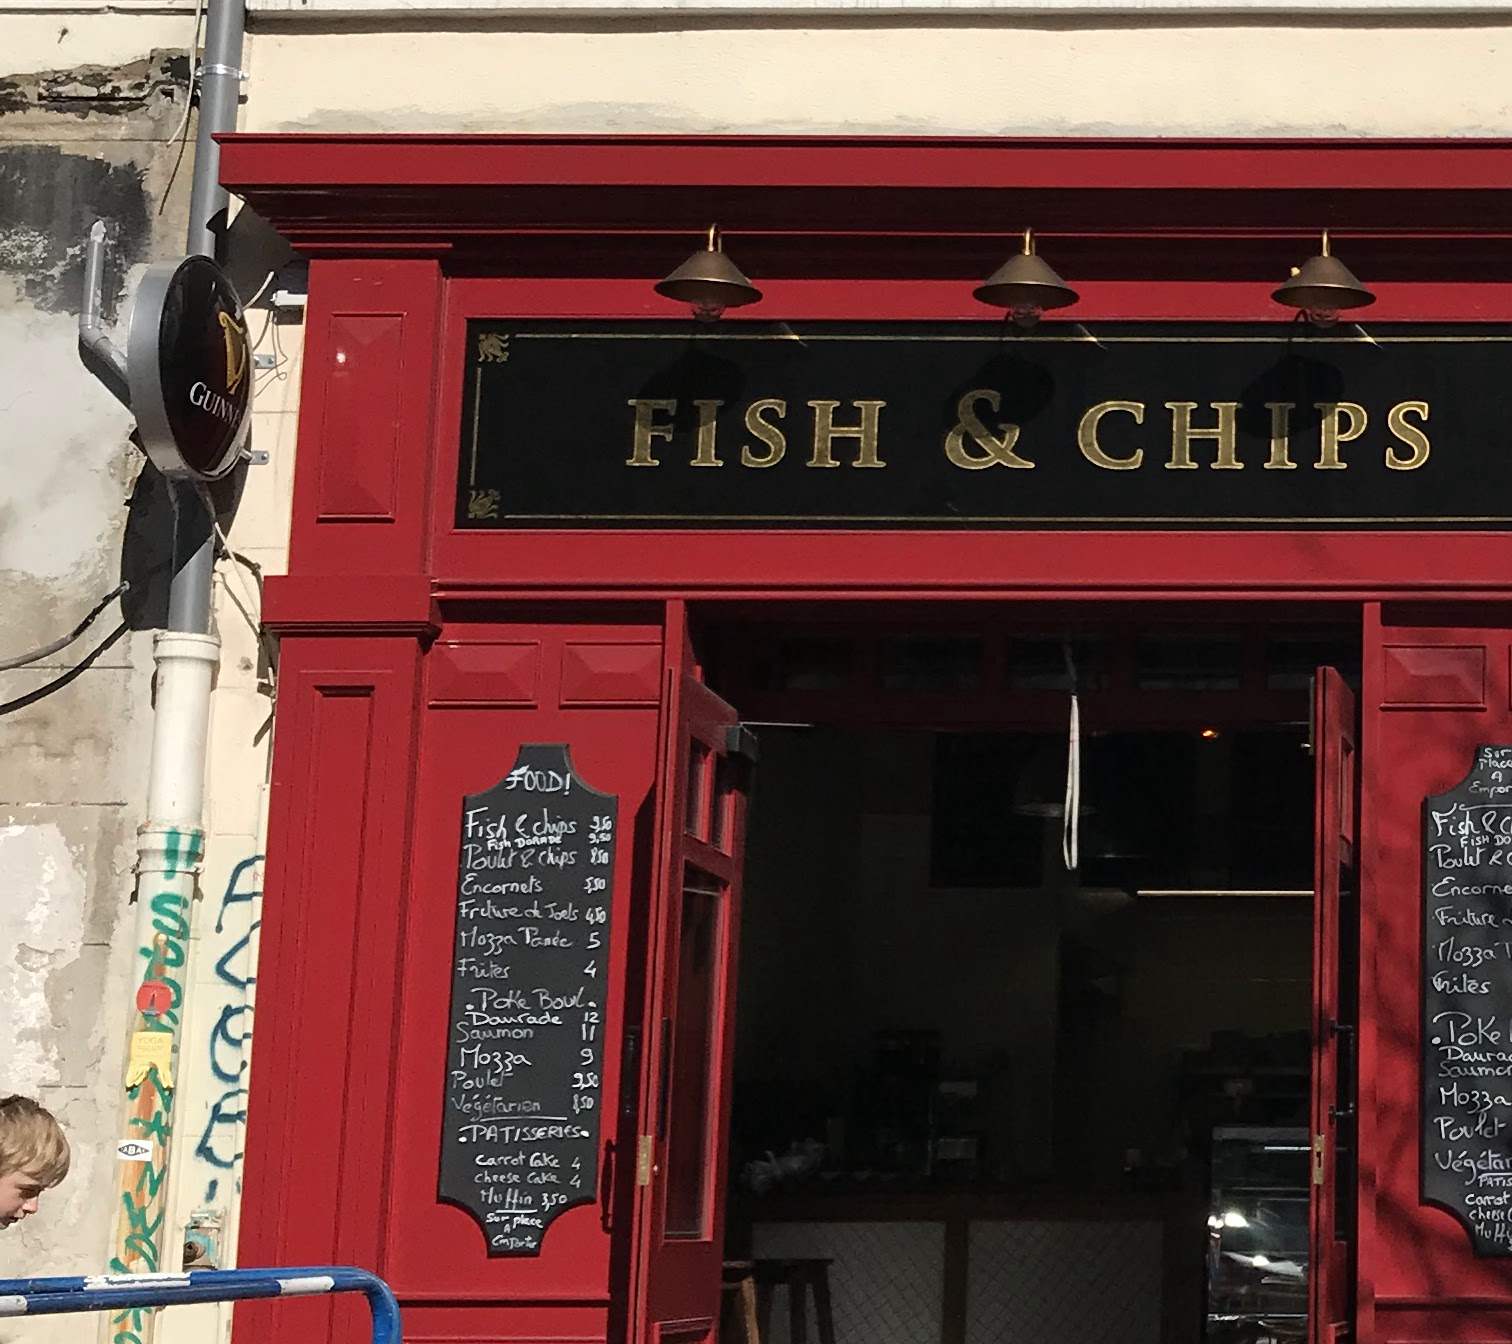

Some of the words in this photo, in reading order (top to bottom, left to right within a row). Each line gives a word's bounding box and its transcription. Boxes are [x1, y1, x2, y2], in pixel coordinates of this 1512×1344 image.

[625, 398, 887, 469] FISH
[944, 389, 1035, 469] &
[1077, 399, 1432, 470] CHIPS
[1483, 747, 1512, 758] Sur
[505, 765, 571, 795] FOOD!
[465, 807, 507, 839] Fish
[1432, 803, 1480, 836] Fish
[462, 844, 517, 869] Poulet
[1429, 844, 1486, 869] Poulet
[461, 873, 543, 895] Encornets
[460, 926, 518, 956] Mozza
[586, 931, 601, 949] 5
[457, 958, 510, 978] Frites
[583, 960, 597, 978] 4
[465, 1011, 563, 1026] Daurade
[585, 1012, 600, 1023] 12
[456, 1021, 534, 1043] Saumon
[582, 1023, 595, 1041] 11
[461, 1043, 532, 1073] Mozza
[580, 1048, 594, 1065] 9
[451, 1069, 514, 1089] Poulet
[1439, 1082, 1512, 1114] Mozza
[1434, 1111, 1506, 1142] Poulet
[571, 1157, 580, 1170] 4
[570, 1174, 580, 1188] 4
[480, 1186, 532, 1210] Muffin
[503, 1223, 511, 1233] A
